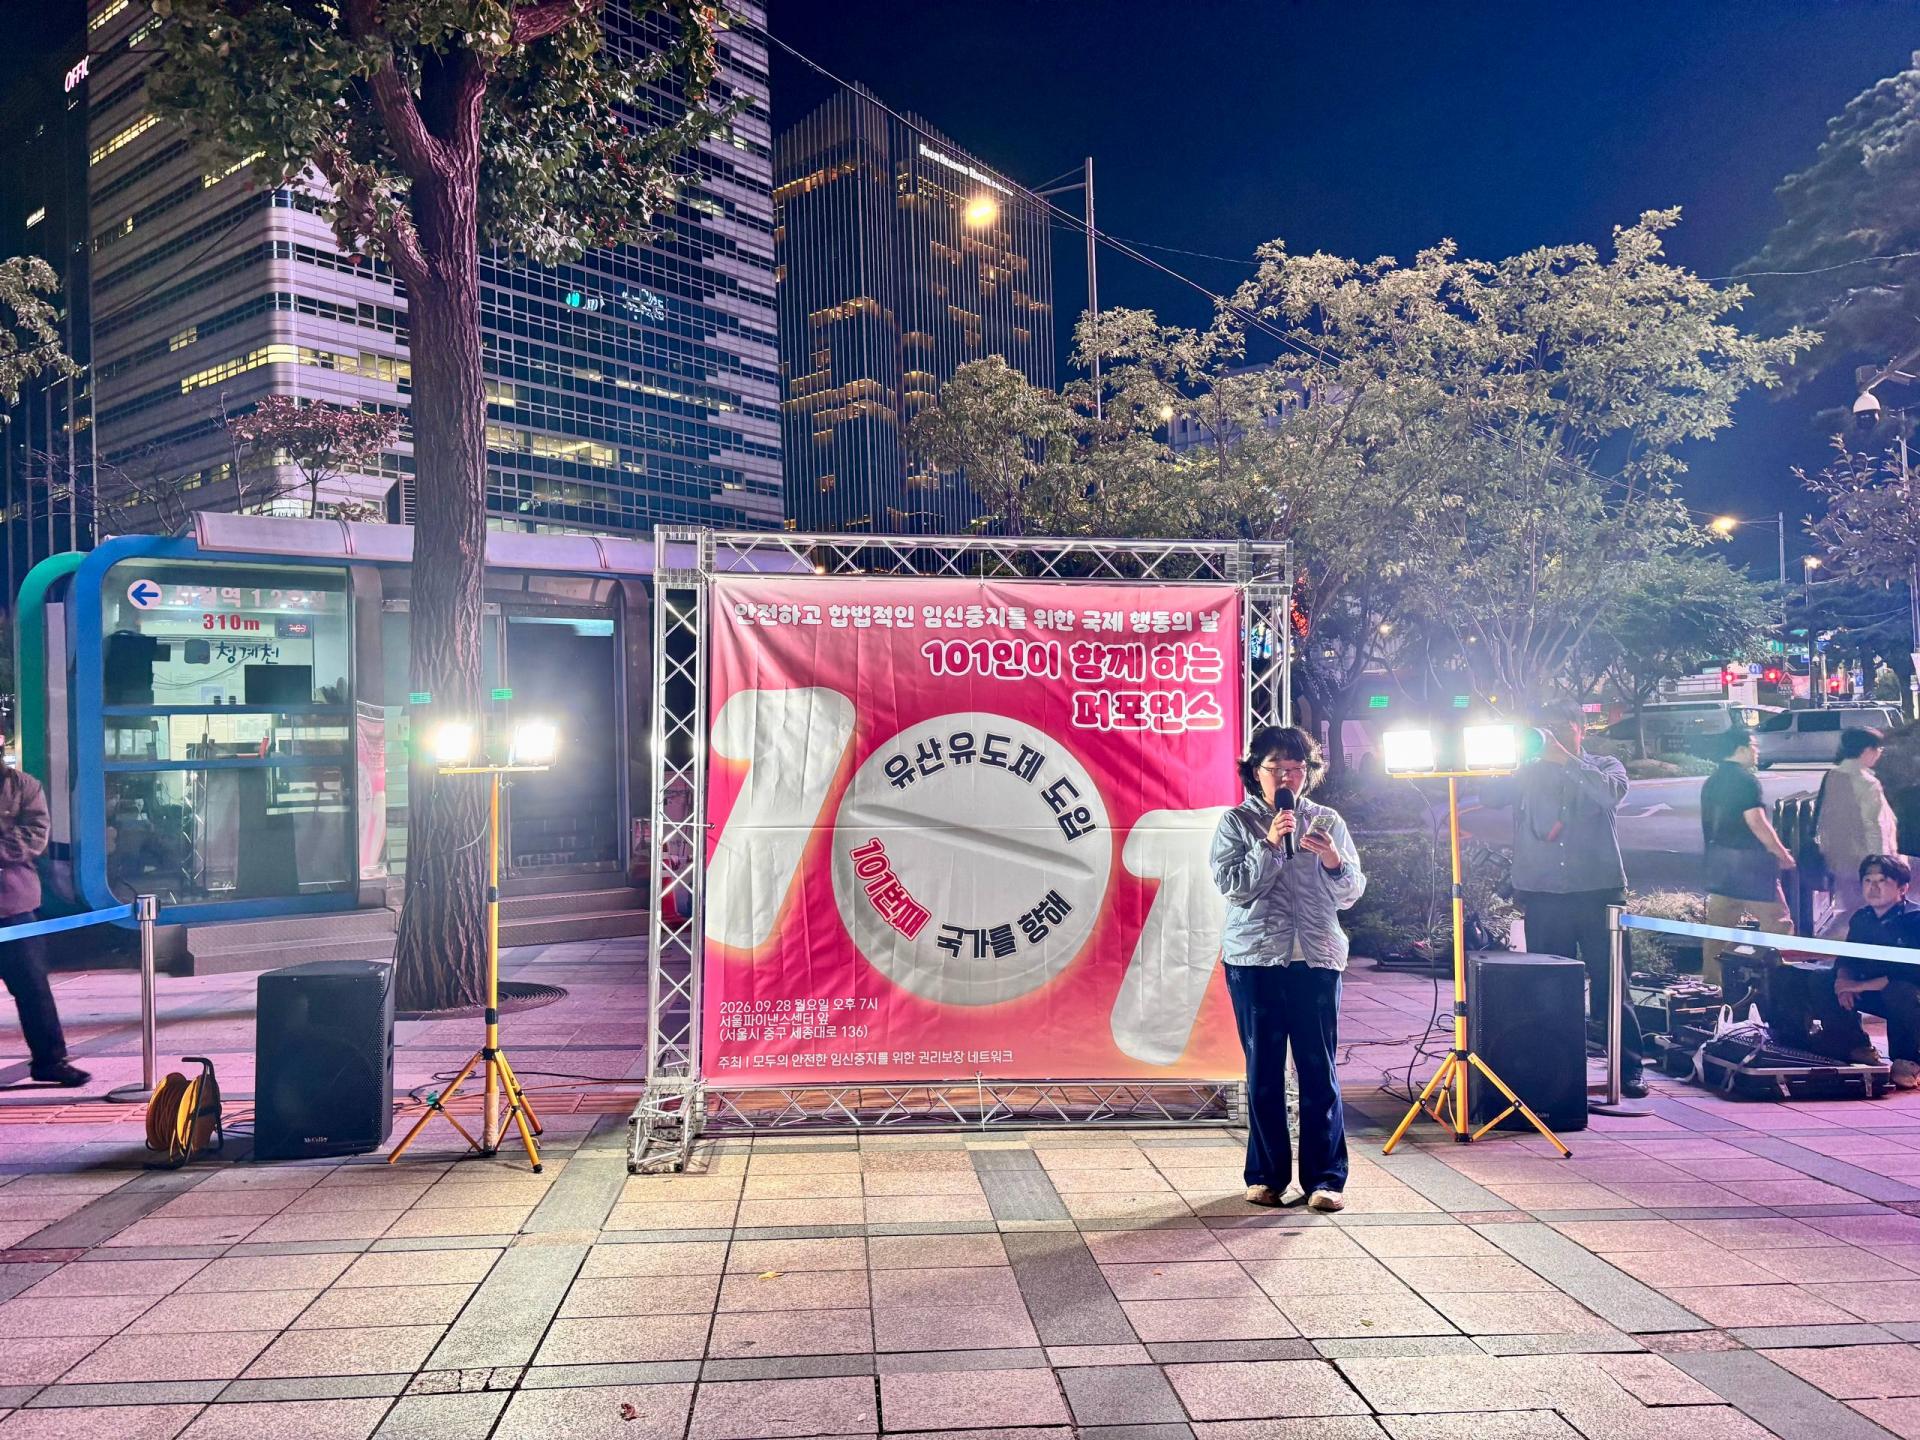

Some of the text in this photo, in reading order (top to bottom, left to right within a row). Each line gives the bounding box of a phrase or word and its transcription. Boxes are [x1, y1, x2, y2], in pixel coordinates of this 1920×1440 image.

[202, 613, 260, 631] 310m
[734, 603, 1221, 634] 안전하고 합법적인 임신중지를 위한 국제 행동의 날
[215, 641, 279, 664] 청계천
[920, 639, 1224, 684] 101인이 함께 하는
[1071, 690, 1224, 734] 퍼포먼스
[884, 732, 1097, 842] 유산유도제 도입
[850, 838, 1074, 958] 101번째 국가를 향해
[719, 997, 878, 1014] 2026.09.28 월요일 오후 7시
[719, 1013, 829, 1027] 서울파이낸스센터 앞
[719, 1025, 868, 1041] (서울시 중구 세종대로 136)
[718, 1056, 742, 1069] 주최
[752, 1055, 789, 1067] 모두의
[791, 1053, 828, 1067] 안전한
[830, 1052, 889, 1066] 임신중지를
[892, 1052, 916, 1065] 위한
[918, 1051, 964, 1064] 권리보장
[967, 1050, 1014, 1064] 네트워크
